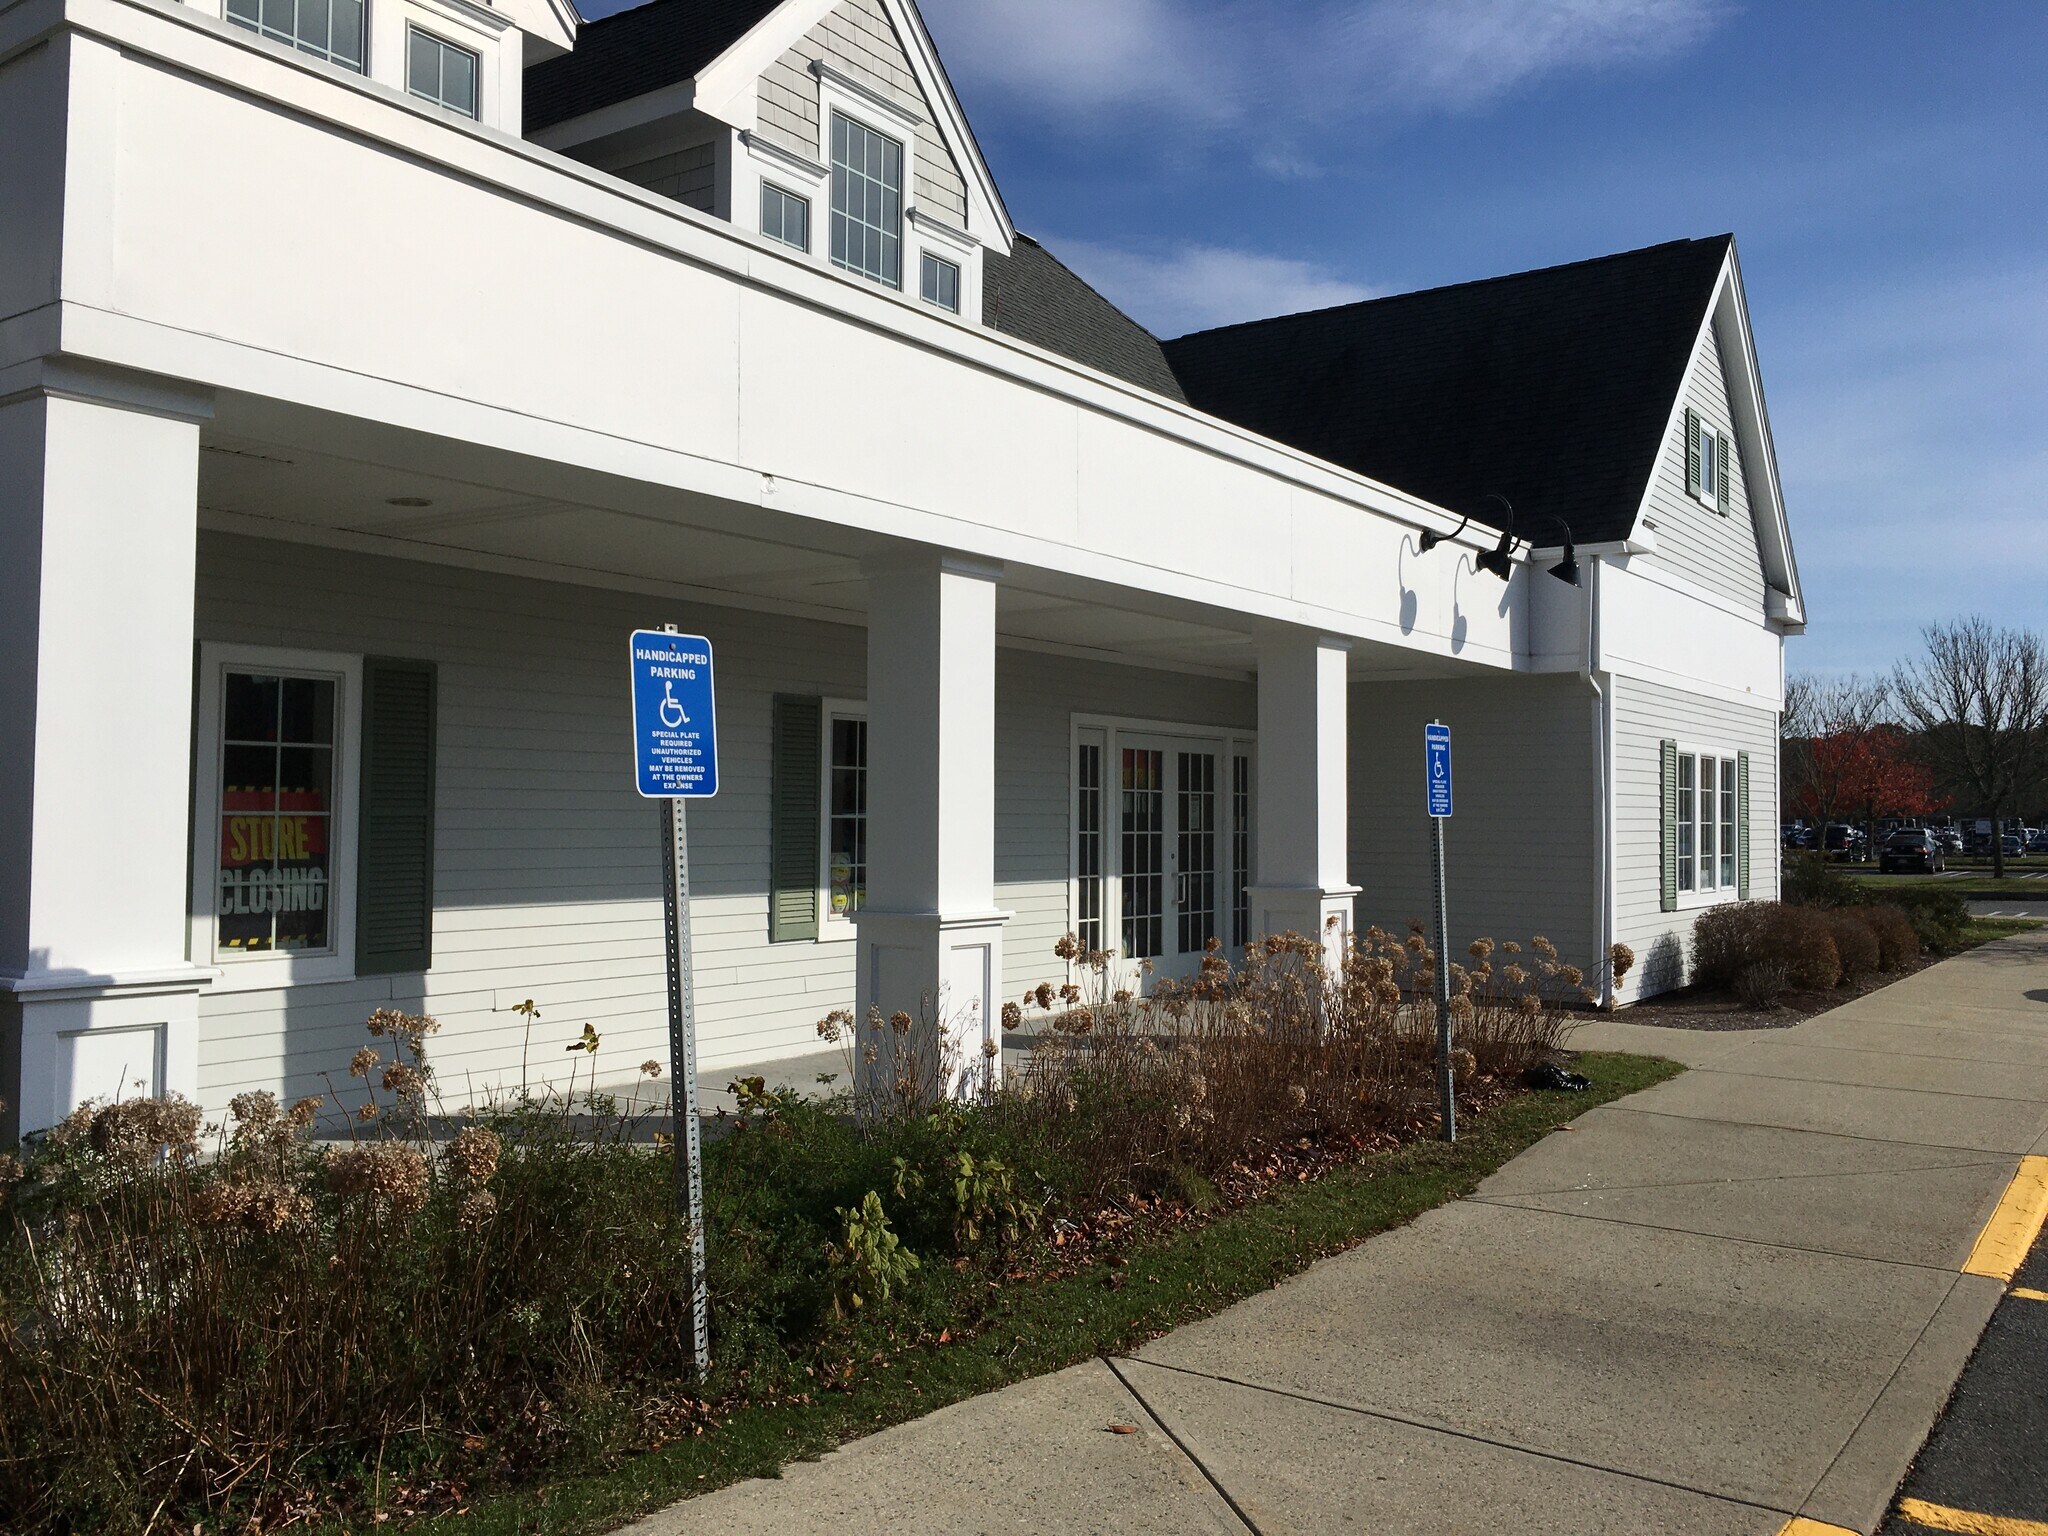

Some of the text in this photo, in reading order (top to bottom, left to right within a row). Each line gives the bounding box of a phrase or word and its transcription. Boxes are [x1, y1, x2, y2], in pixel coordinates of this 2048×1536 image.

[636, 648, 708, 665] HANDICAPPED
[650, 666, 696, 680] PARKING
[651, 730, 700, 739] SPECIAL PLATE
[660, 739, 693, 747] REQUIRED
[651, 748, 702, 756] UNAUTHORIZED
[661, 756, 693, 764] VEHICLES
[674, 765, 705, 773] REMOVED
[652, 773, 661, 781] AT
[662, 773, 675, 781] THE
[230, 816, 310, 861] STORE
[220, 866, 324, 916] CLOSING
